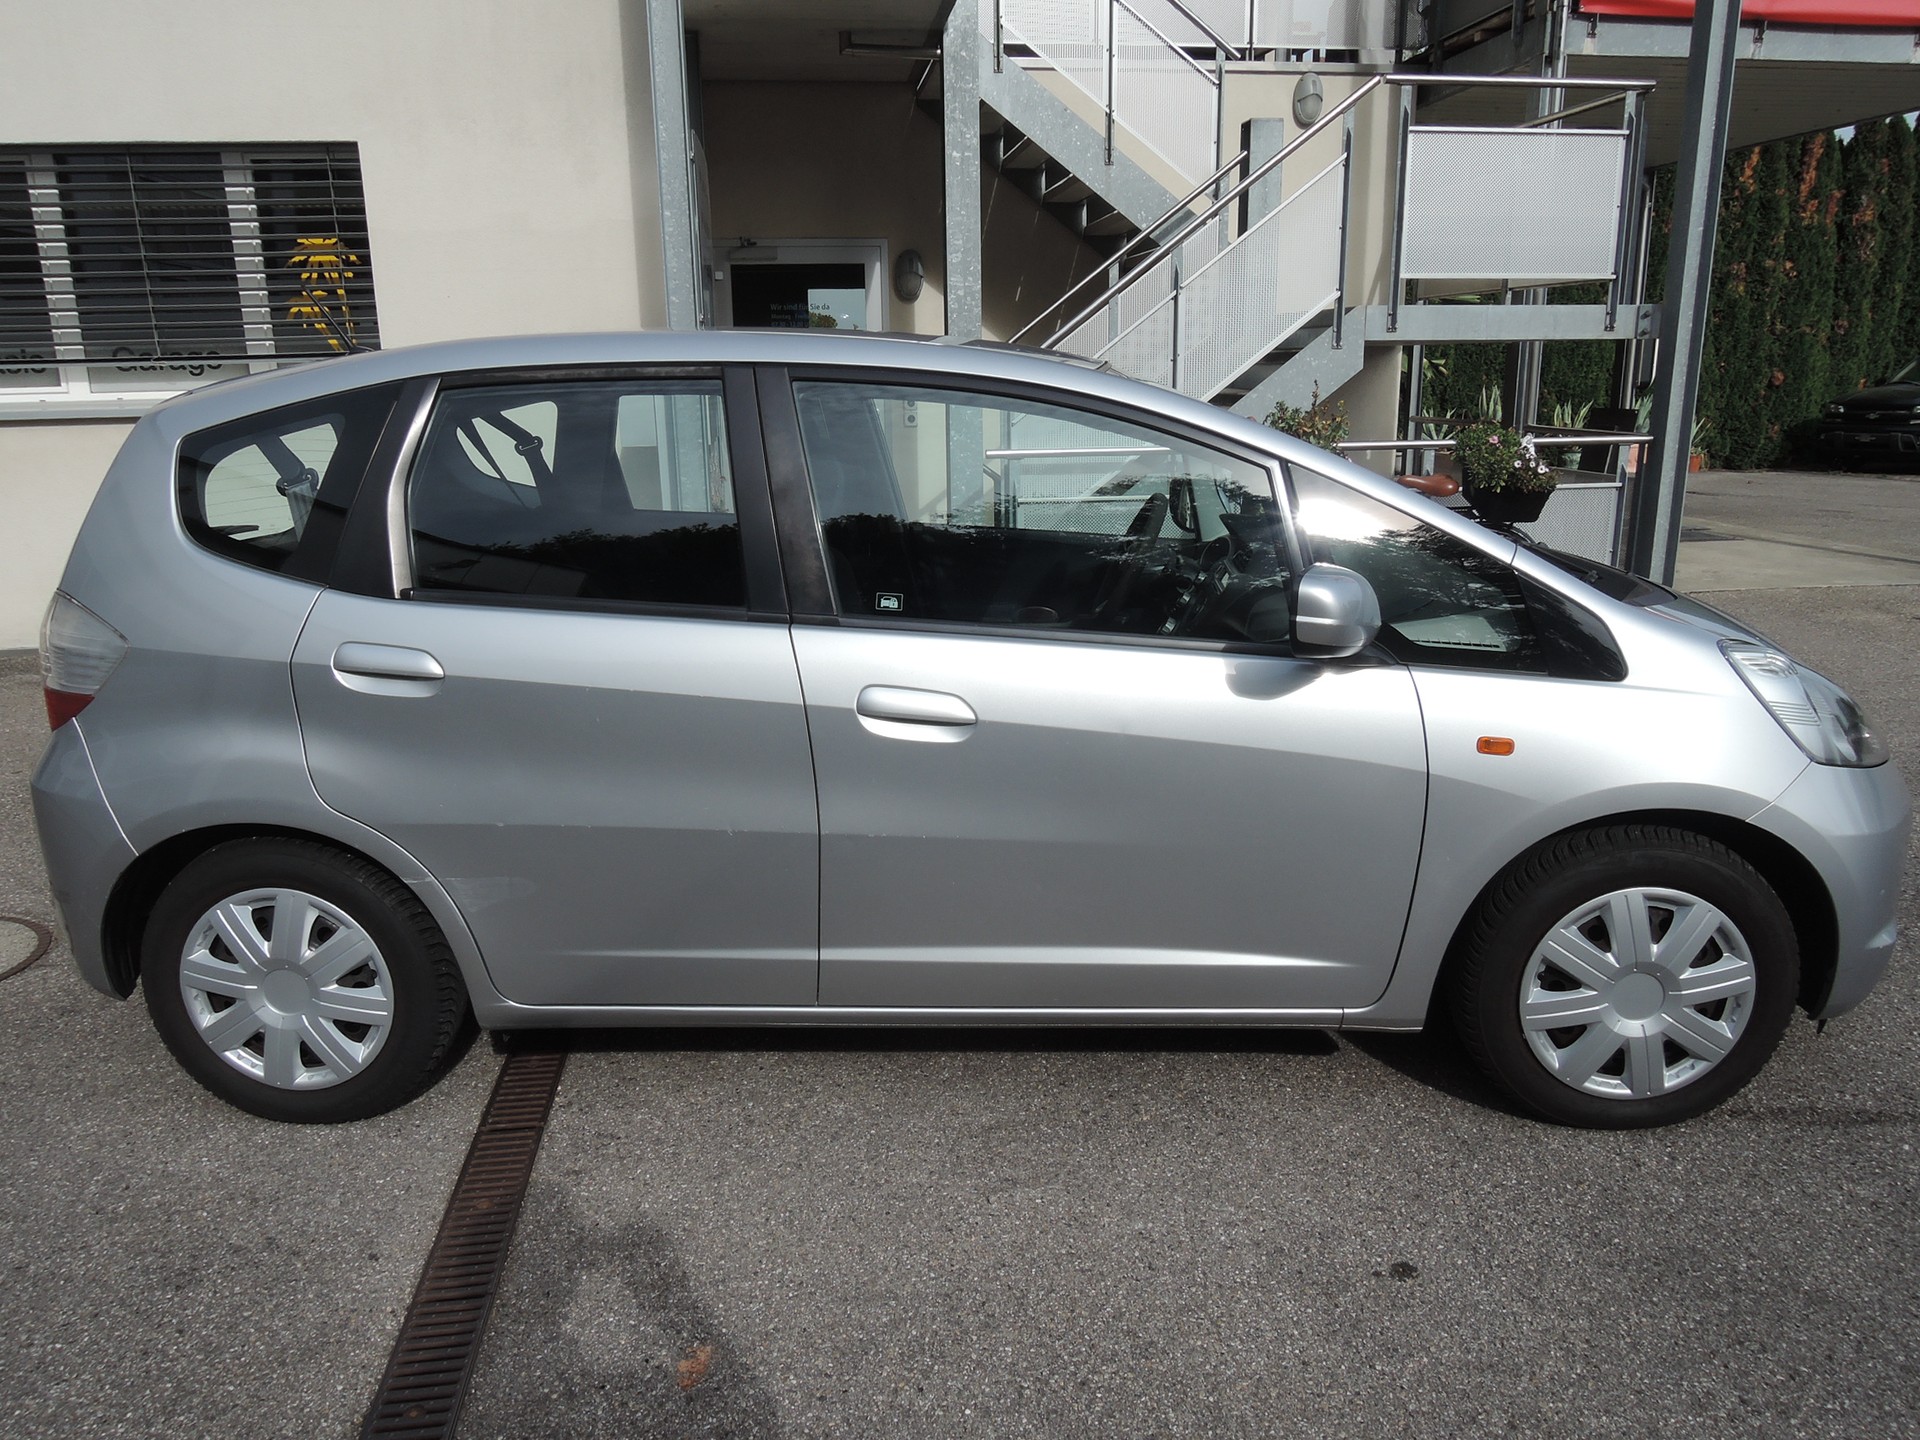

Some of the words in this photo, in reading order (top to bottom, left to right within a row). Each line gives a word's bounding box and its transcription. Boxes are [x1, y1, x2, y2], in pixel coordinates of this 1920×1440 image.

[770, 303, 781, 311] Wir
[782, 303, 798, 311] sind
[810, 303, 821, 311] Sie
[821, 303, 830, 311] da
